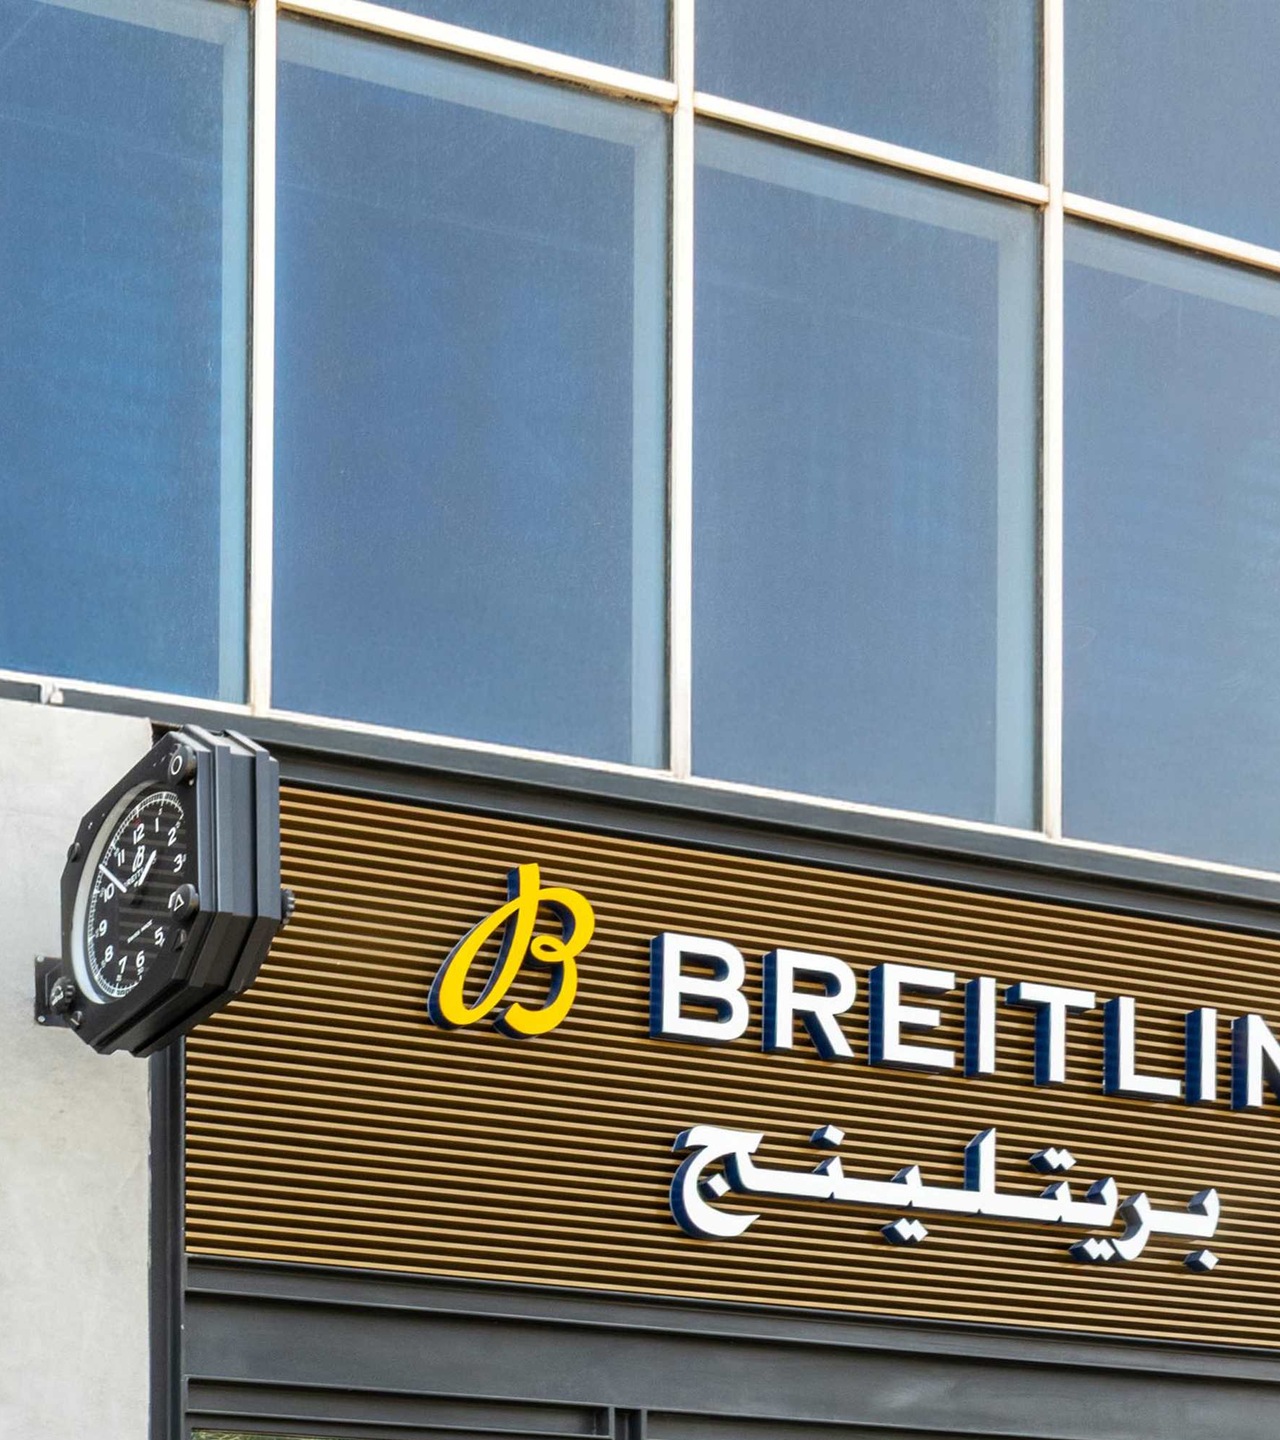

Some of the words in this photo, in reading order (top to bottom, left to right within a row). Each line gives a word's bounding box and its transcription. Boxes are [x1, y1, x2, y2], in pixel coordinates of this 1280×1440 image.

[132, 823, 145, 845] 12
[167, 826, 177, 847] 2
[117, 849, 125, 867] 11
[173, 853, 183, 873] 3
[103, 883, 114, 903] 10
[98, 919, 108, 937] 9
[154, 926, 164, 945] 5
[104, 945, 114, 963] 8
[135, 950, 145, 967] 6
[436, 863, 596, 1036] B
[118, 955, 128, 974] 7
[678, 1124, 1221, 1271] بريتلينج
